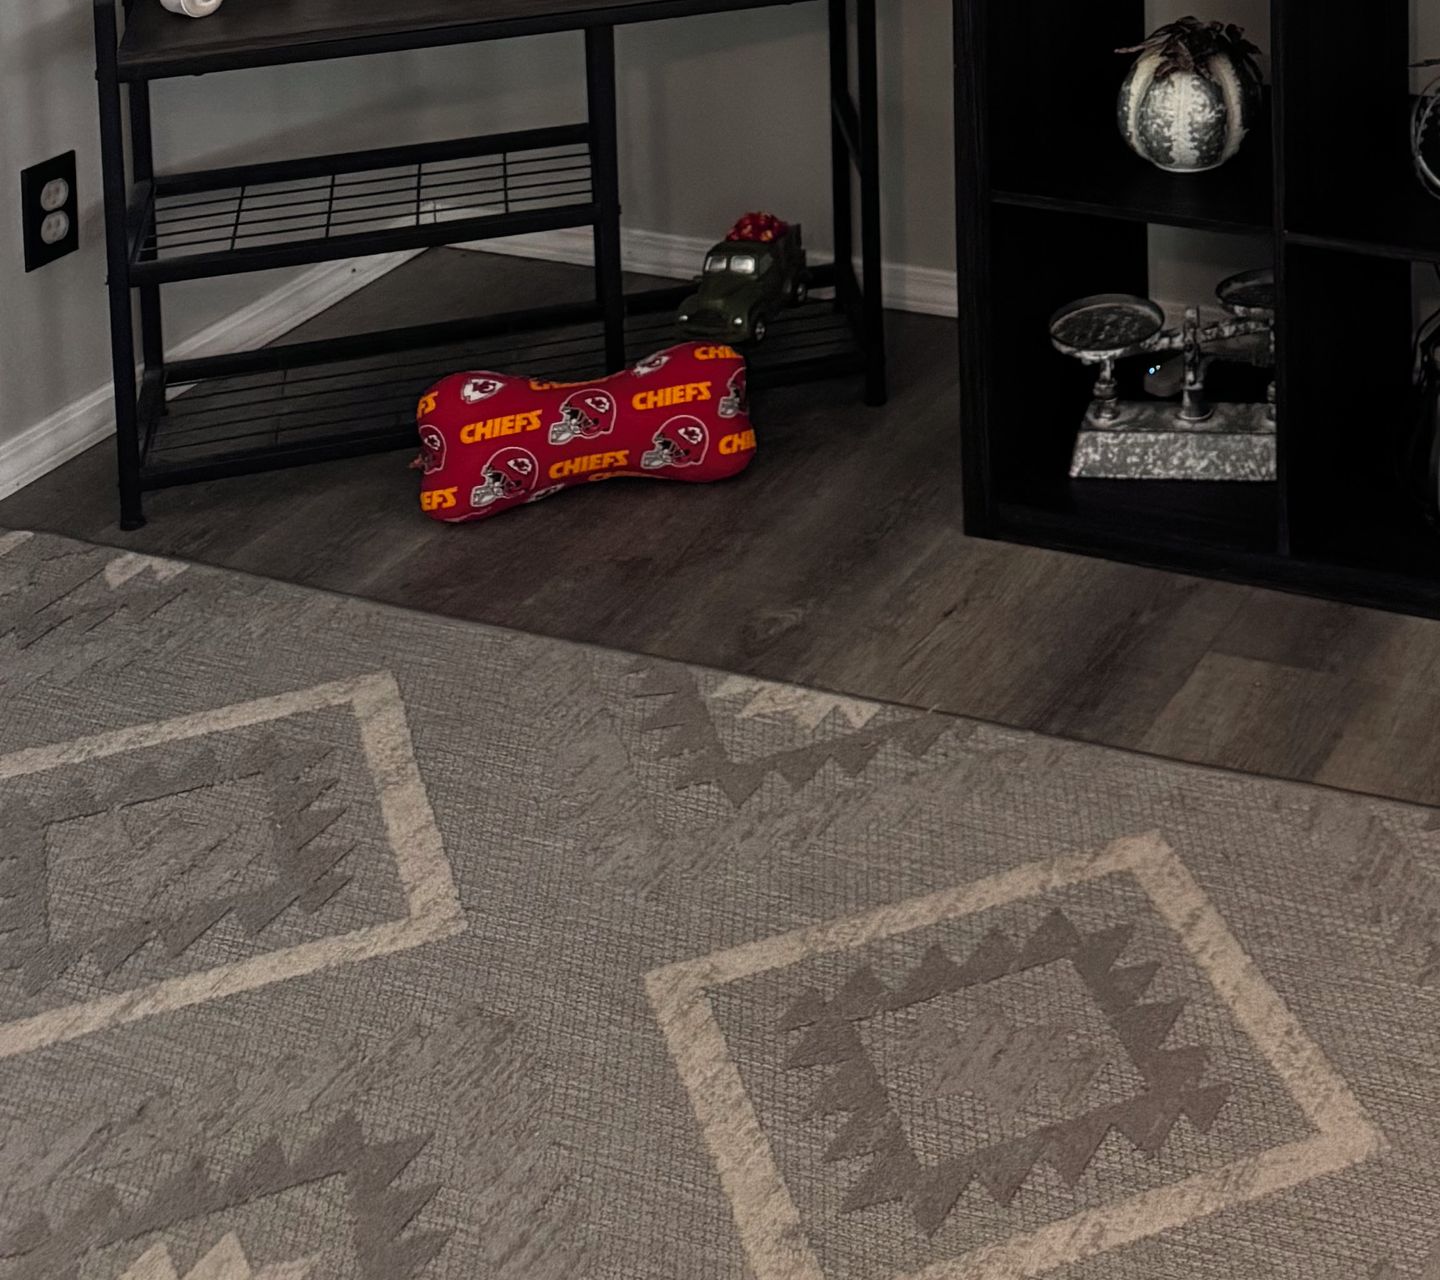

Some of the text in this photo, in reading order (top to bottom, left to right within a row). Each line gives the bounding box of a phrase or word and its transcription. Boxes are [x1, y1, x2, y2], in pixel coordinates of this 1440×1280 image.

[632, 381, 712, 411] CHIEFS
[460, 410, 543, 444] CHIEFS
[718, 429, 756, 455] CHI
[548, 450, 630, 480] CHIEFS
